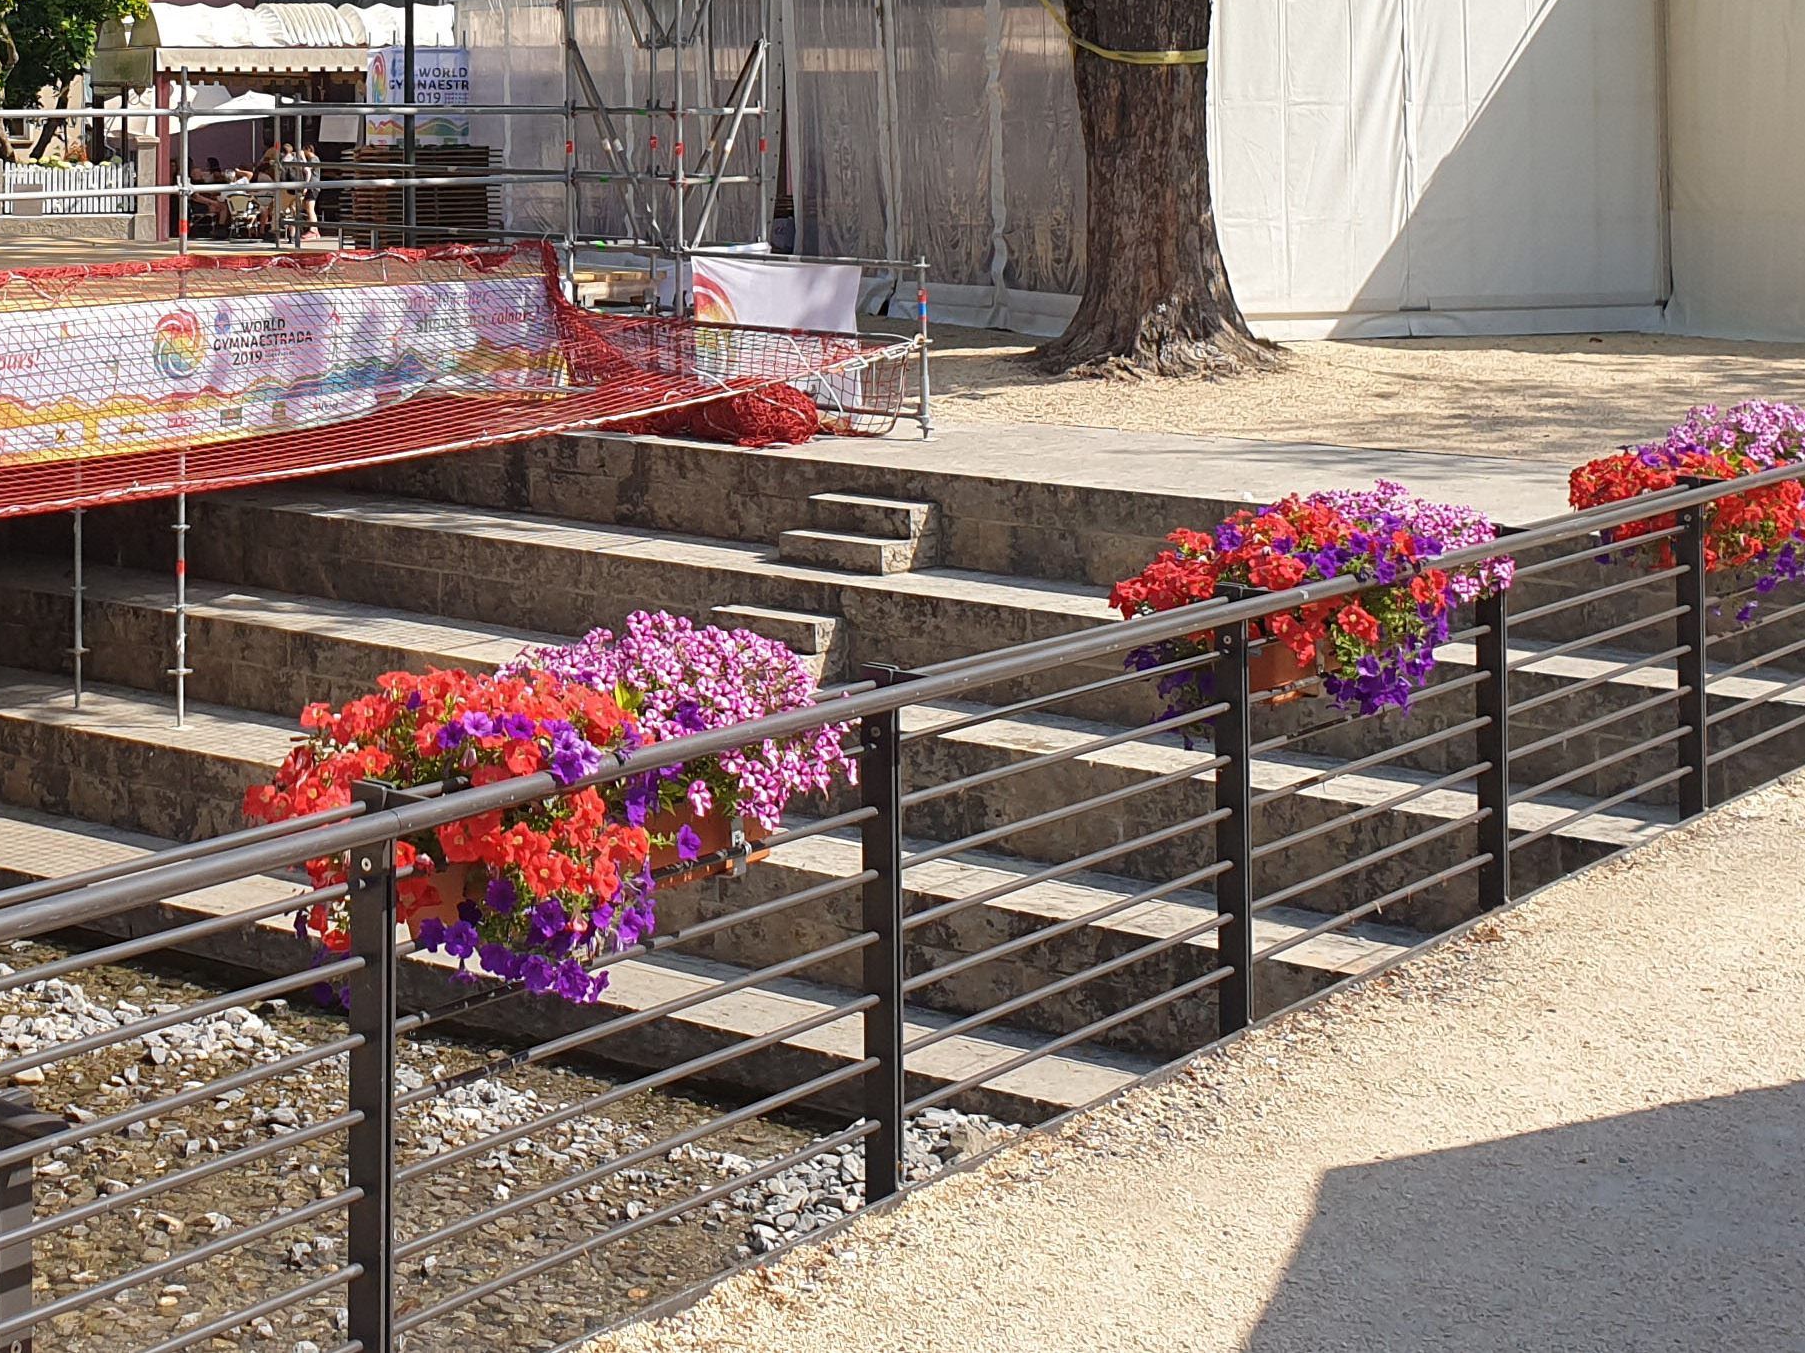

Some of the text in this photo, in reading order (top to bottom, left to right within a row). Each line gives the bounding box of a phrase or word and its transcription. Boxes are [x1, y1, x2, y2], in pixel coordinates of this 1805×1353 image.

[418, 67, 468, 78] WORLD
[389, 79, 469, 91] GYNAESTR
[414, 92, 441, 104] 019
[241, 317, 286, 333] WORLD
[213, 330, 313, 351] GYMNAESTRADA
[232, 350, 263, 366] 2019
